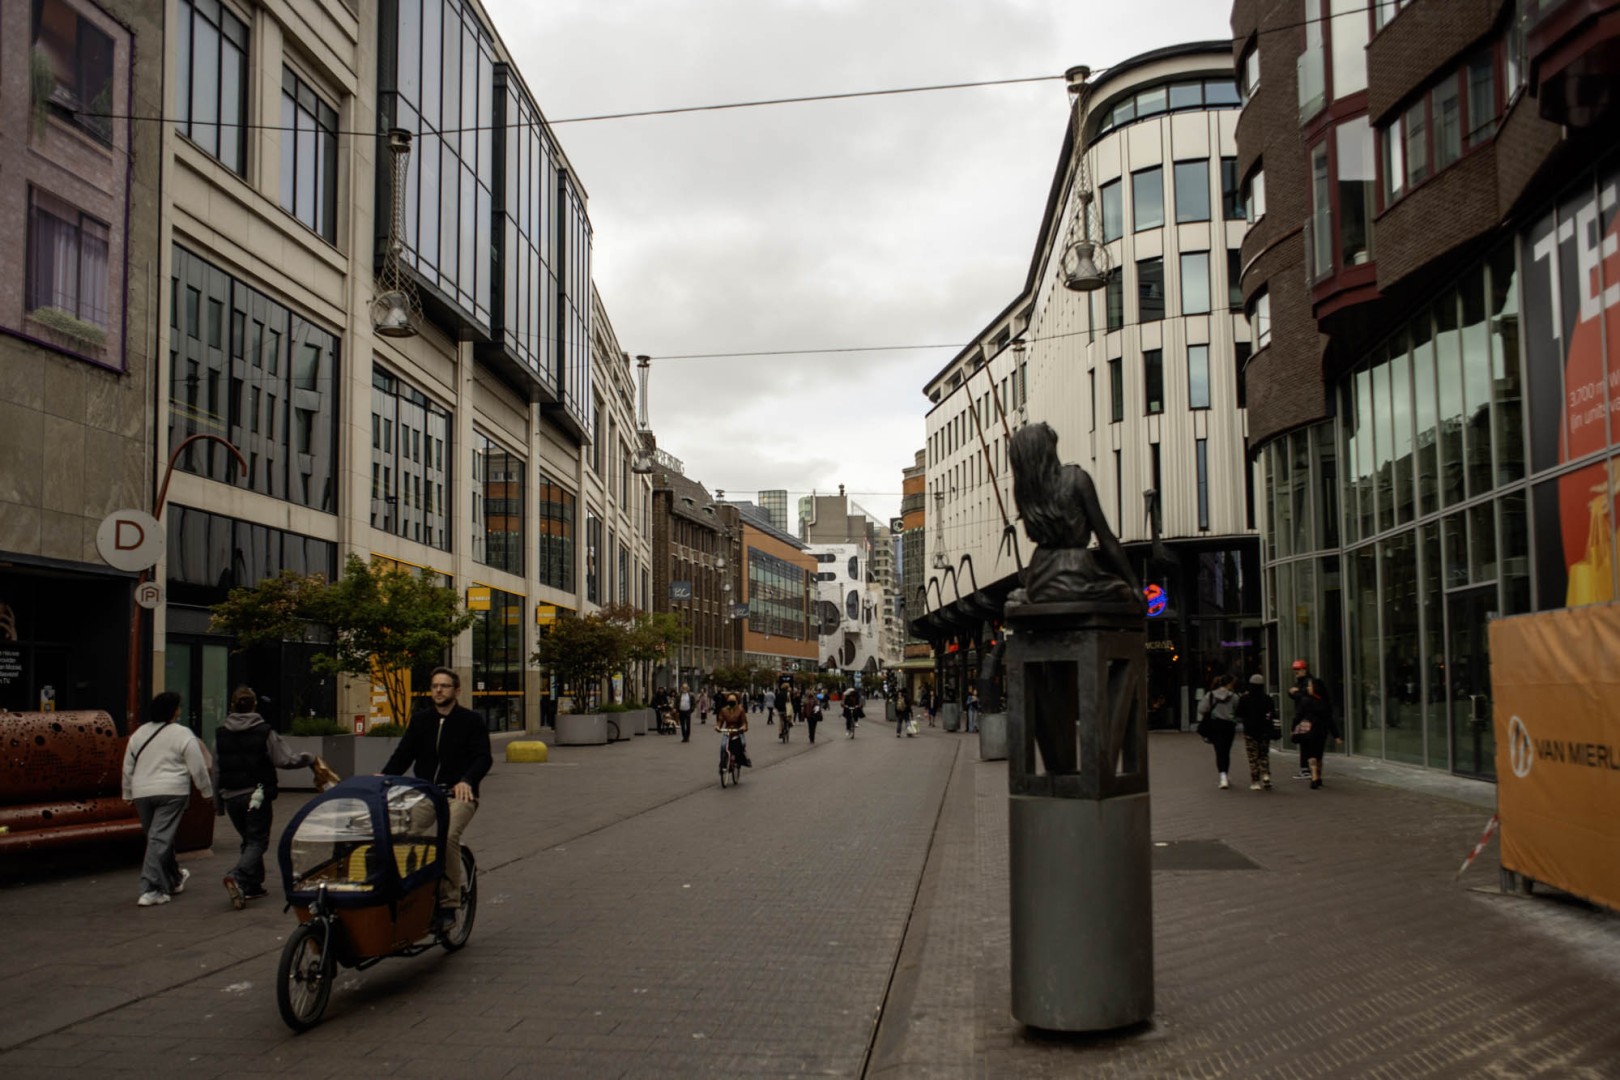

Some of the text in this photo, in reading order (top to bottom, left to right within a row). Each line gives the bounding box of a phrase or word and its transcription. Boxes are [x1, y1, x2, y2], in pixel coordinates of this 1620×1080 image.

[1534, 184, 1620, 340] TE
[115, 519, 144, 551] D
[145, 590, 155, 602] P
[1534, 738, 1620, 771] VAN MIERL
